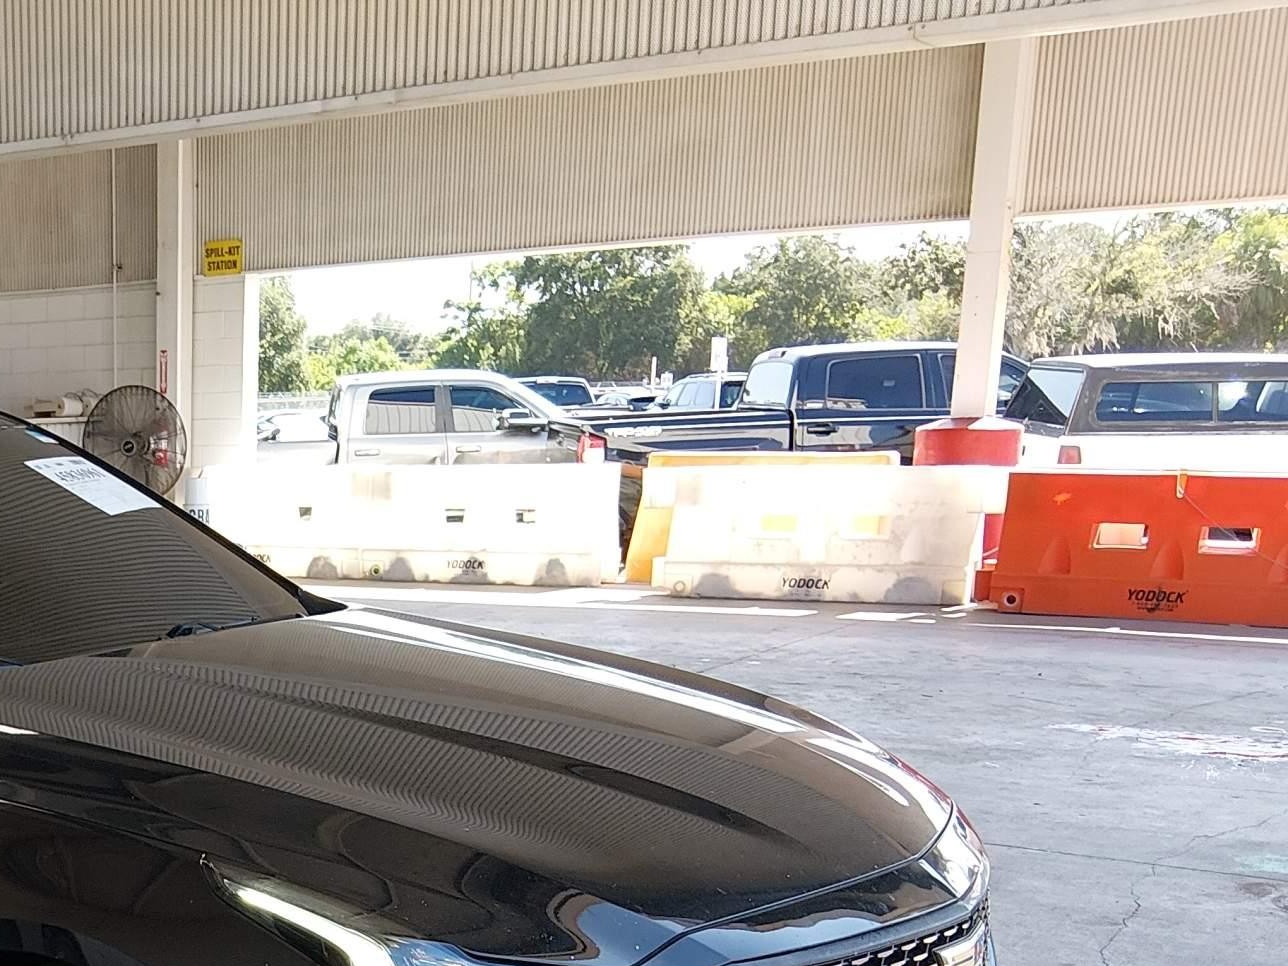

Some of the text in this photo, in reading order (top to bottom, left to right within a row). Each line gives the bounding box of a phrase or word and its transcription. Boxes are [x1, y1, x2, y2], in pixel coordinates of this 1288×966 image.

[205, 246, 240, 258] SPILL-KIT
[208, 260, 237, 271] STATION
[782, 577, 831, 590] YODOCK
[1128, 589, 1186, 603] YODOCK
